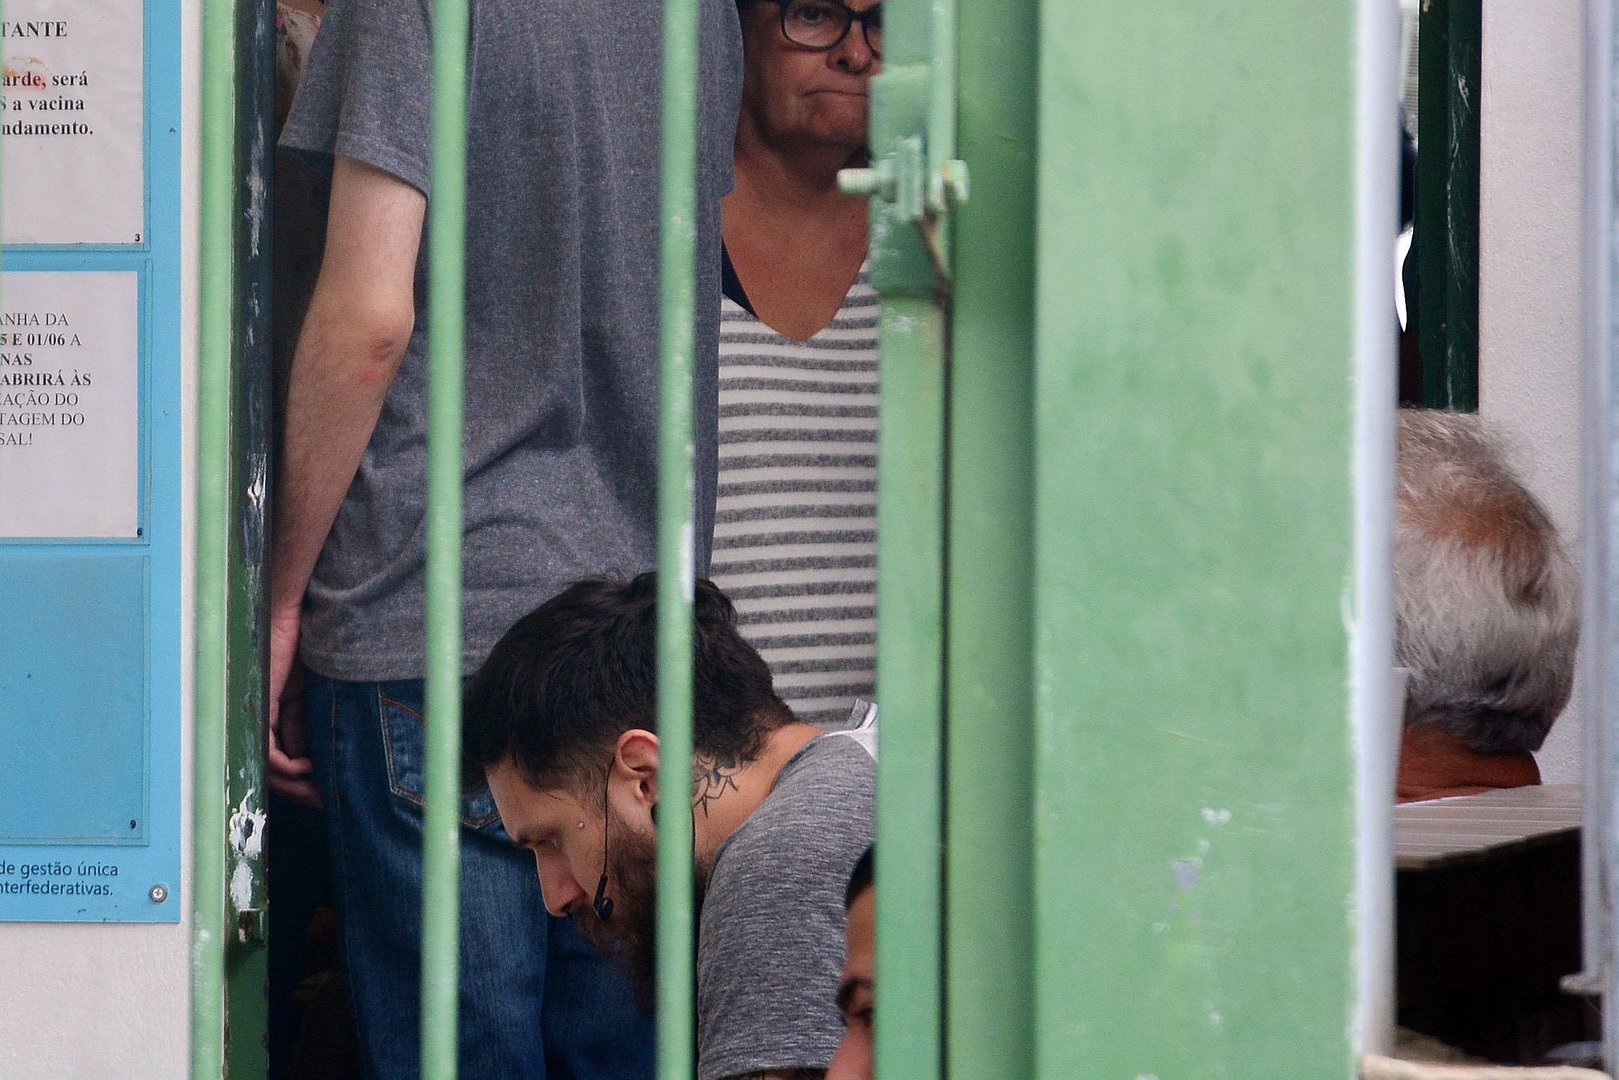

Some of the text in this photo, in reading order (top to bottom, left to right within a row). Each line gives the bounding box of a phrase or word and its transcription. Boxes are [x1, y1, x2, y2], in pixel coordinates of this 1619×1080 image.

[51, 70, 89, 87] será
[13, 100, 23, 111] a
[28, 95, 85, 111] vacina
[134, 232, 141, 242] 3
[45, 312, 70, 327] DA
[12, 332, 23, 346] E
[26, 332, 66, 347] 01/06
[69, 333, 82, 346] A
[0, 369, 93, 387] ABRIRÁ ÀS
[54, 392, 80, 407] DO
[60, 412, 86, 427] DO
[20, 861, 73, 880] gestão
[77, 860, 119, 877] única
